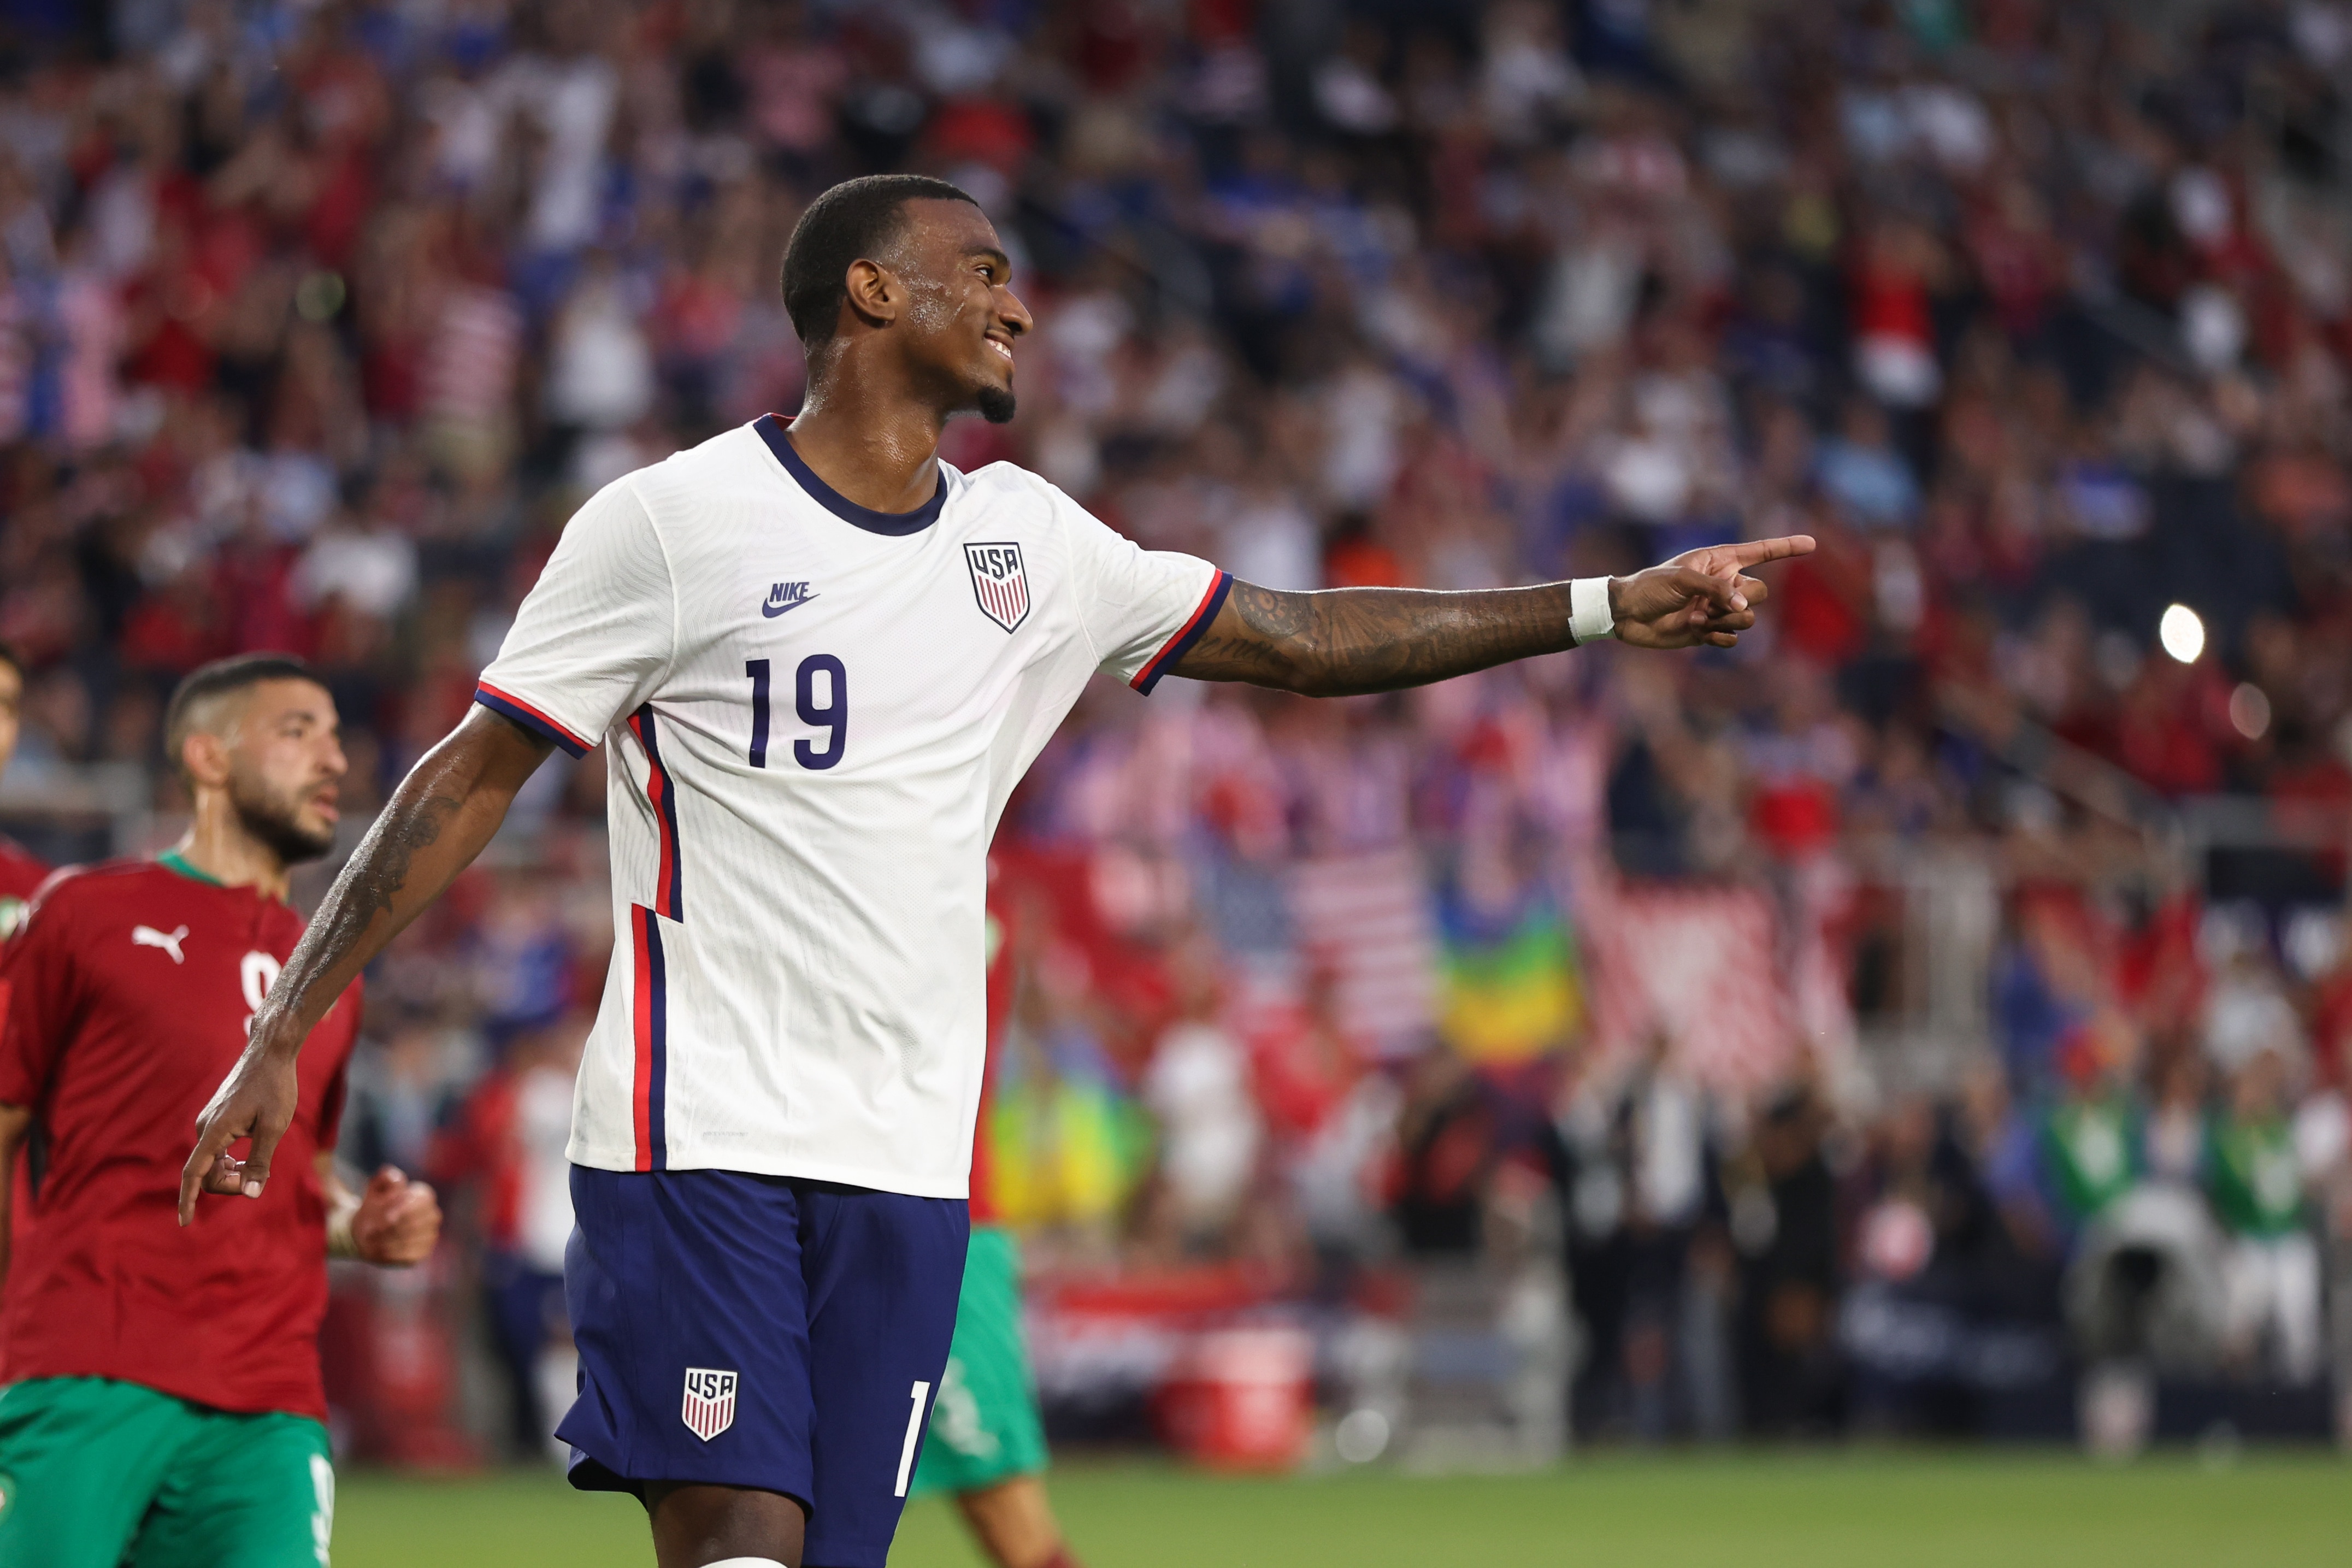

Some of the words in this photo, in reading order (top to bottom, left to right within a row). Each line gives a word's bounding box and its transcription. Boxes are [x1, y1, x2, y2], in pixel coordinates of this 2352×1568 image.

[971, 549, 1018, 581] USA
[769, 581, 810, 602] NIKE
[746, 653, 848, 770] 19
[688, 1372, 734, 1400] USA
[894, 1380, 930, 1498] 1
